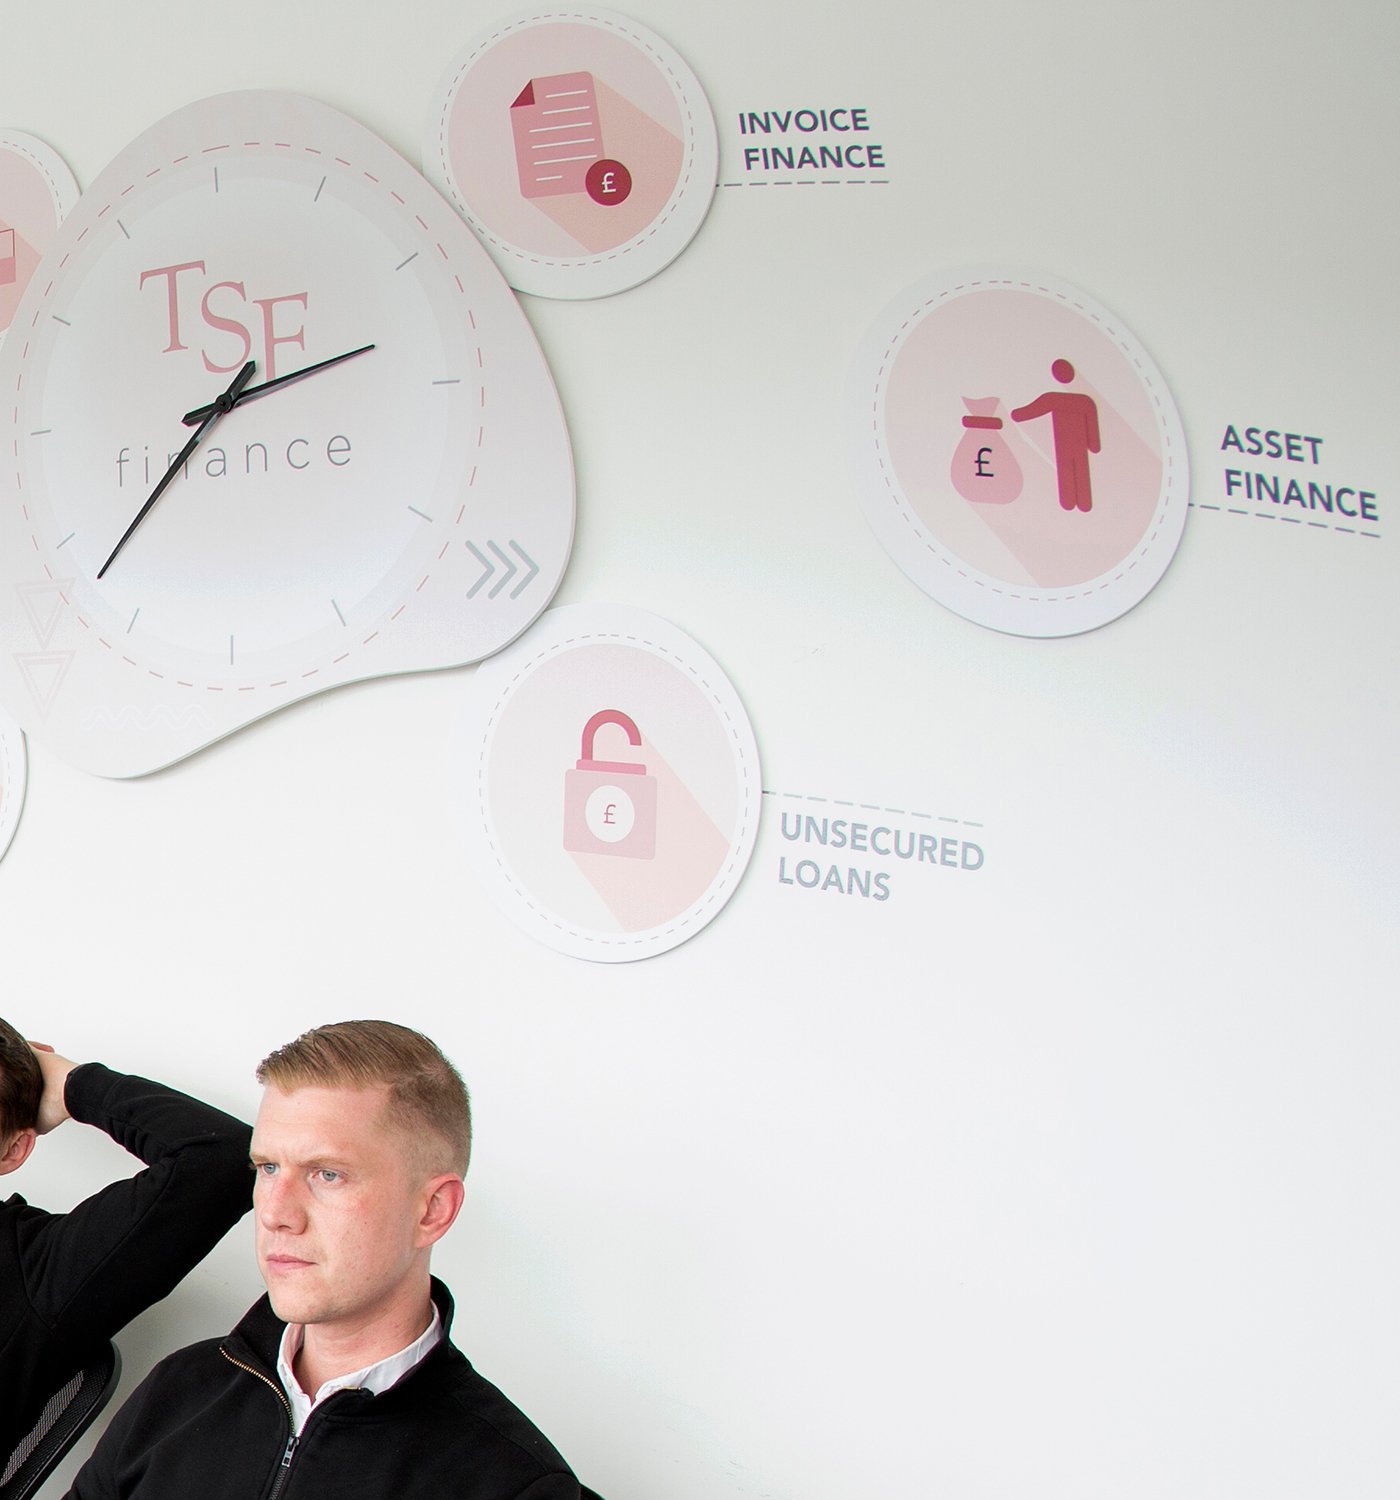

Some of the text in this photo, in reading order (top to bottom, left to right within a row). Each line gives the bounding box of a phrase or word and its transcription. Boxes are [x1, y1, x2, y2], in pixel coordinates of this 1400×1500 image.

[738, 108, 870, 135] INVOICE
[744, 145, 886, 171] FINANCE
[138, 259, 309, 382] TSF
[1220, 424, 1323, 465] ASSET
[1224, 468, 1380, 521] FINANCE
[780, 812, 985, 871] UNSECURED
[778, 857, 890, 901] LOANS
